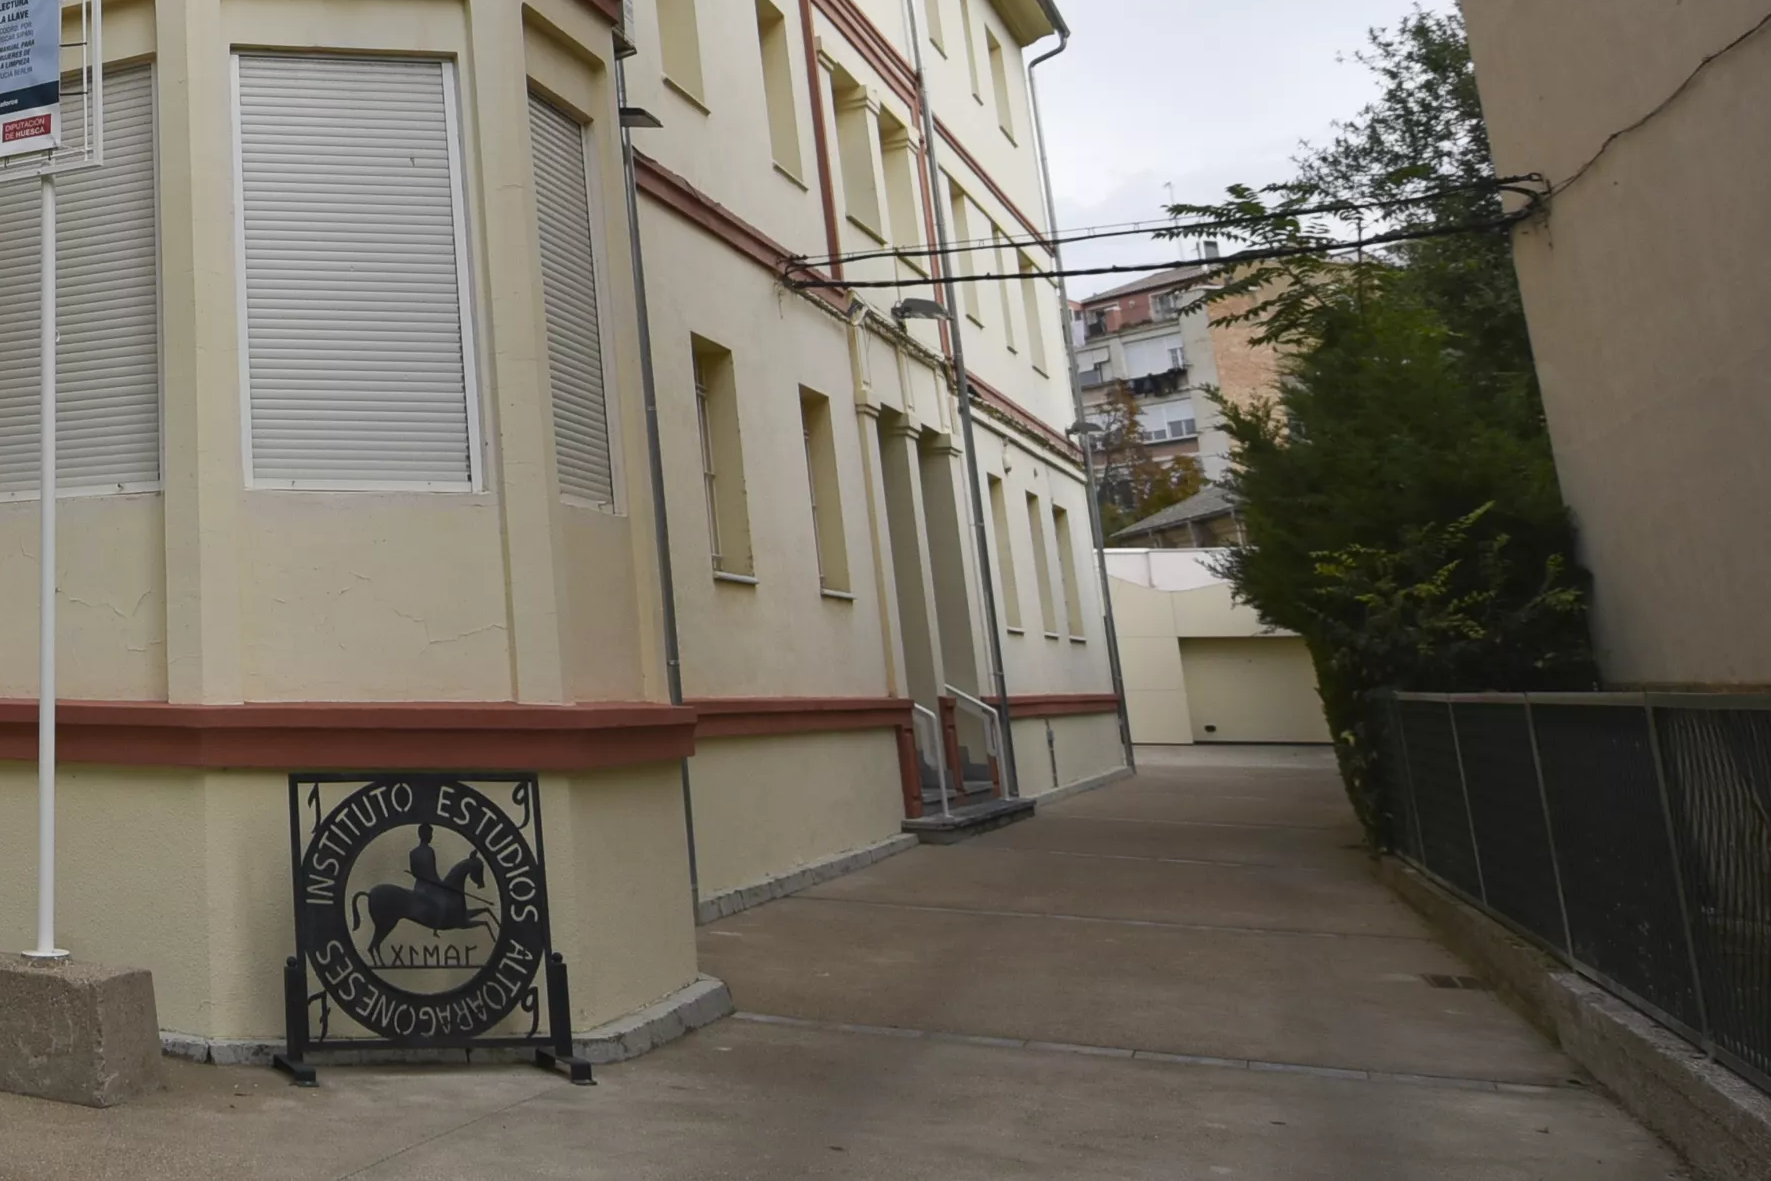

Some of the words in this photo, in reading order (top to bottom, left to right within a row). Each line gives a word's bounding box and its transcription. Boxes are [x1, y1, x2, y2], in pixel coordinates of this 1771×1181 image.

[8, 10, 28, 22] LLAVE
[21, 39, 34, 48] PARA
[0, 99, 18, 107] aforos
[5, 118, 44, 132] DIPUTACIÓN
[5, 132, 14, 140] DE
[16, 127, 44, 137] HUESCA
[306, 783, 413, 904] INSTITUTO
[437, 785, 539, 922] ESTUDIOS
[316, 939, 534, 1036] ALTOARAGONESES
